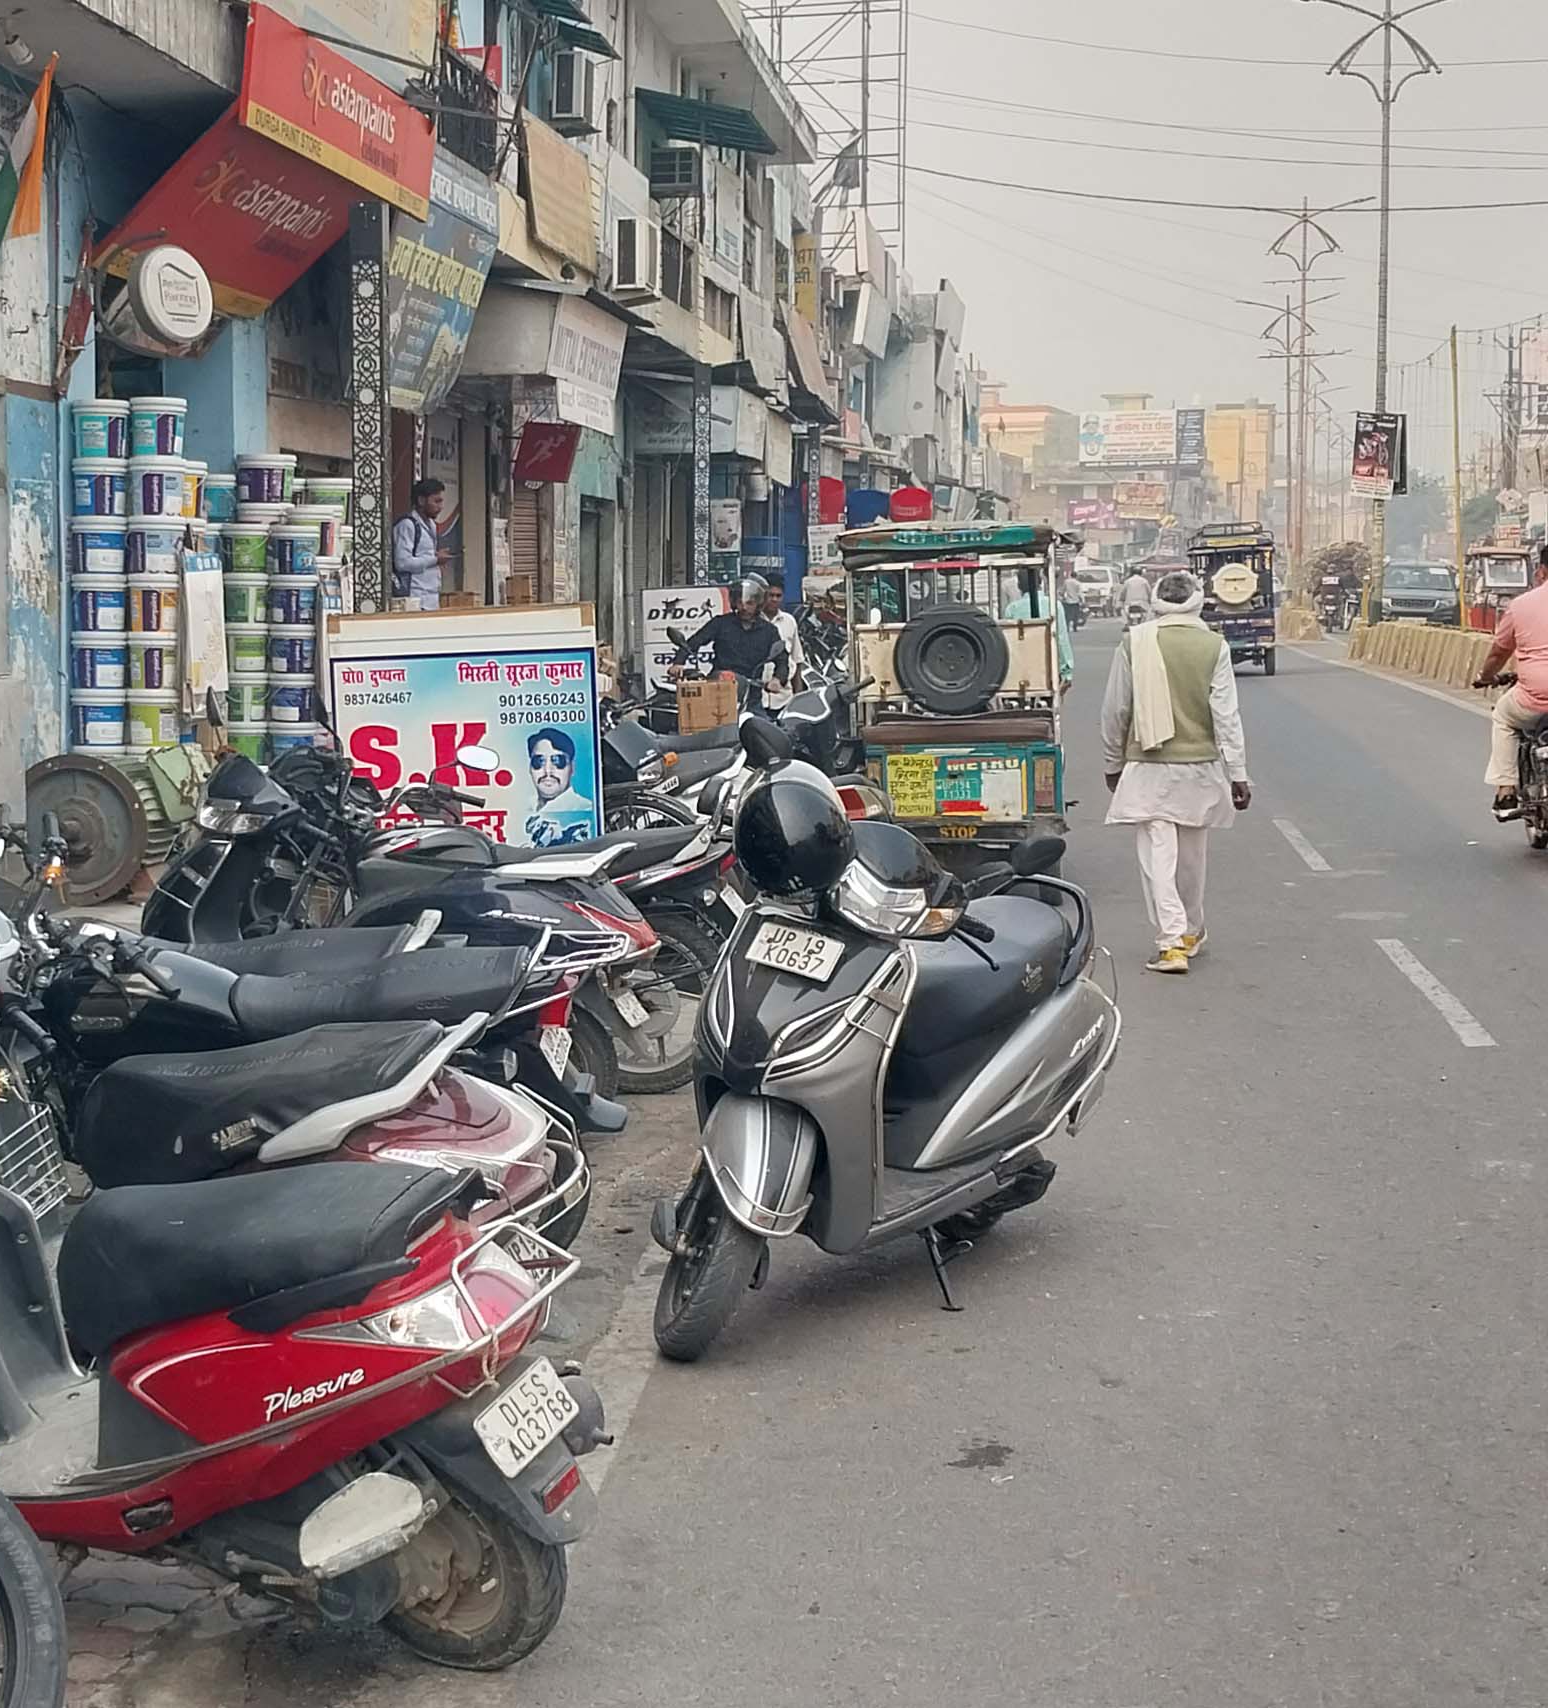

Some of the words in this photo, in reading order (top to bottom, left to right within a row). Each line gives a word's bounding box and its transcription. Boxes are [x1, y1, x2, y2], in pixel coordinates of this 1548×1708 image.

[331, 73, 397, 146] asianpaints
[232, 175, 333, 243] asianpaints
[646, 607, 700, 621] DTDC
[545, 660, 584, 685] कुमार
[343, 691, 413, 706] 9837426467
[499, 692, 586, 707] 9012650243
[499, 710, 586, 725] 9870840300
[939, 825, 978, 839] STOP
[770, 927, 797, 947] UP
[803, 936, 826, 955] 19
[762, 943, 825, 974] K0637
[262, 1367, 366, 1423] Pleasure
